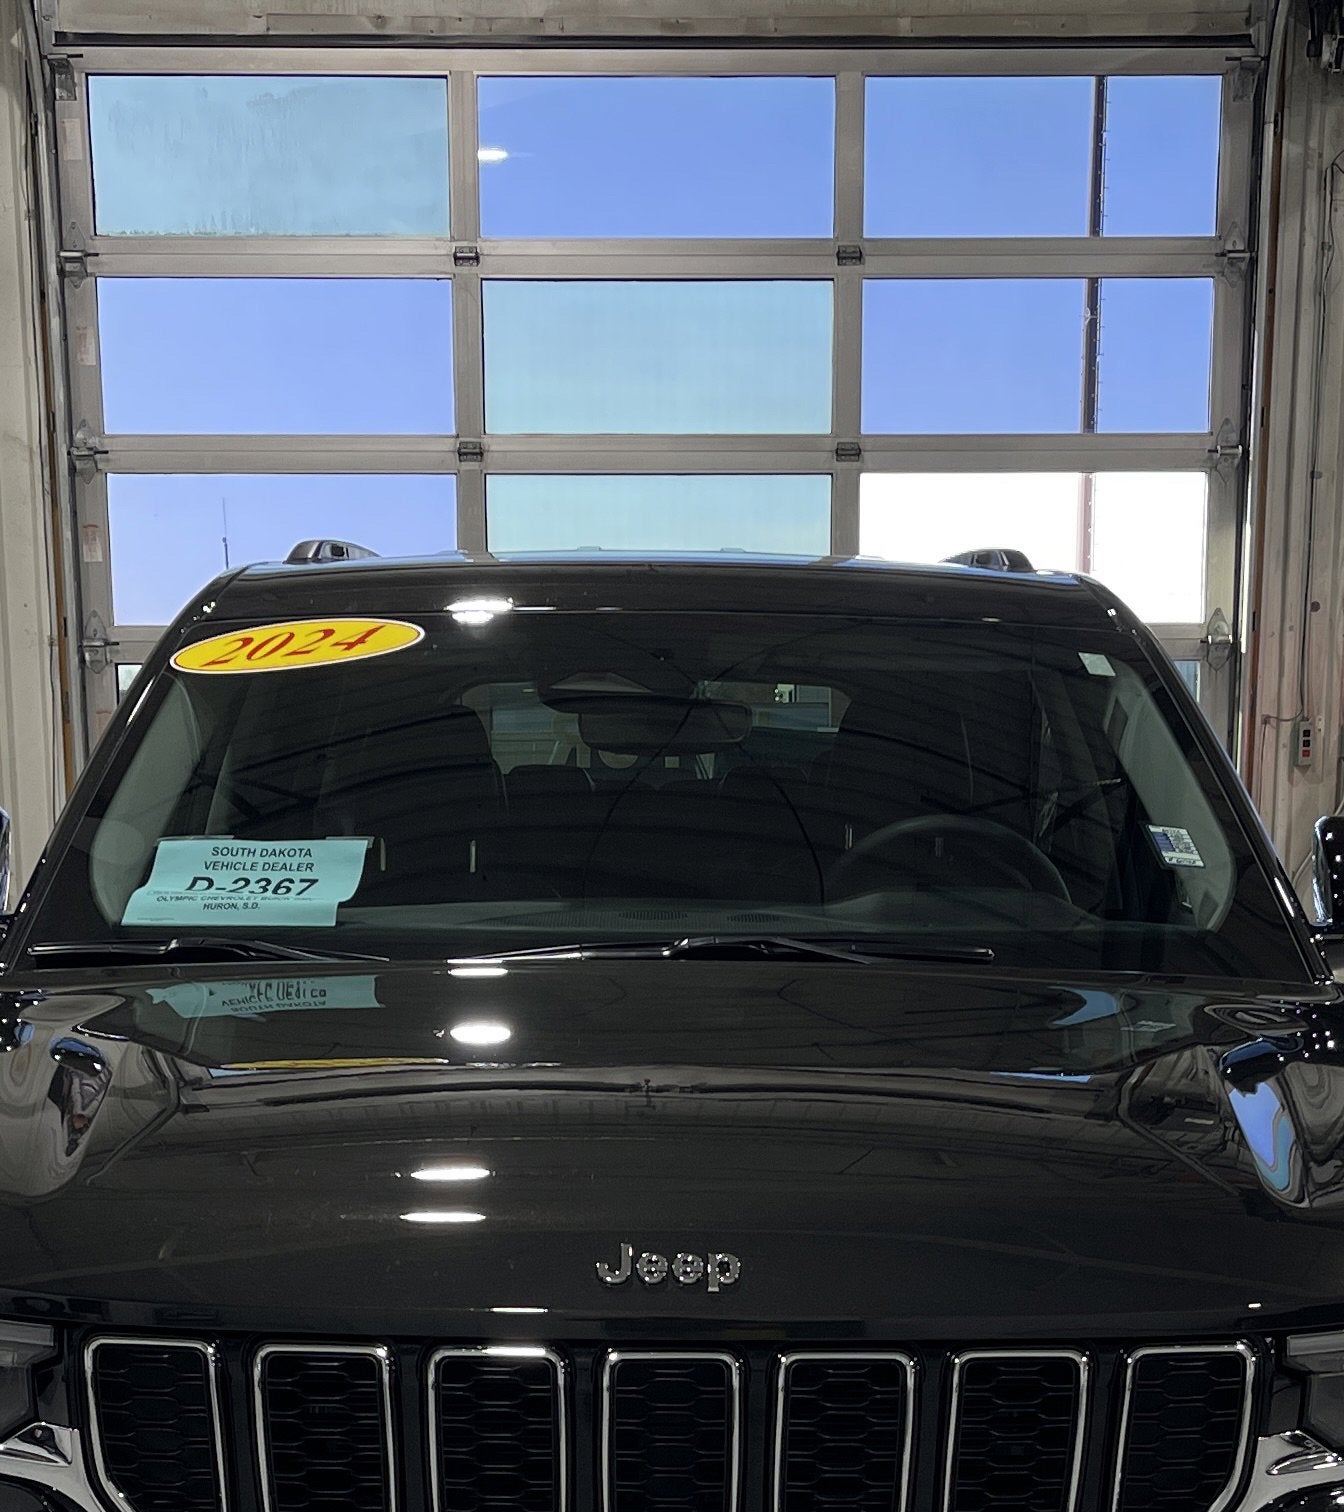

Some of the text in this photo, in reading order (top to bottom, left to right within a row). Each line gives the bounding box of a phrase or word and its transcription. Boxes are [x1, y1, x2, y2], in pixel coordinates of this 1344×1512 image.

[199, 624, 386, 668] 2024
[211, 847, 312, 858] SOUTH DAKOTA
[204, 861, 314, 872] VEHICLE DEALER
[185, 876, 319, 896] D-2367
[203, 902, 239, 911] HURON,
[596, 1243, 741, 1292] Jeep
